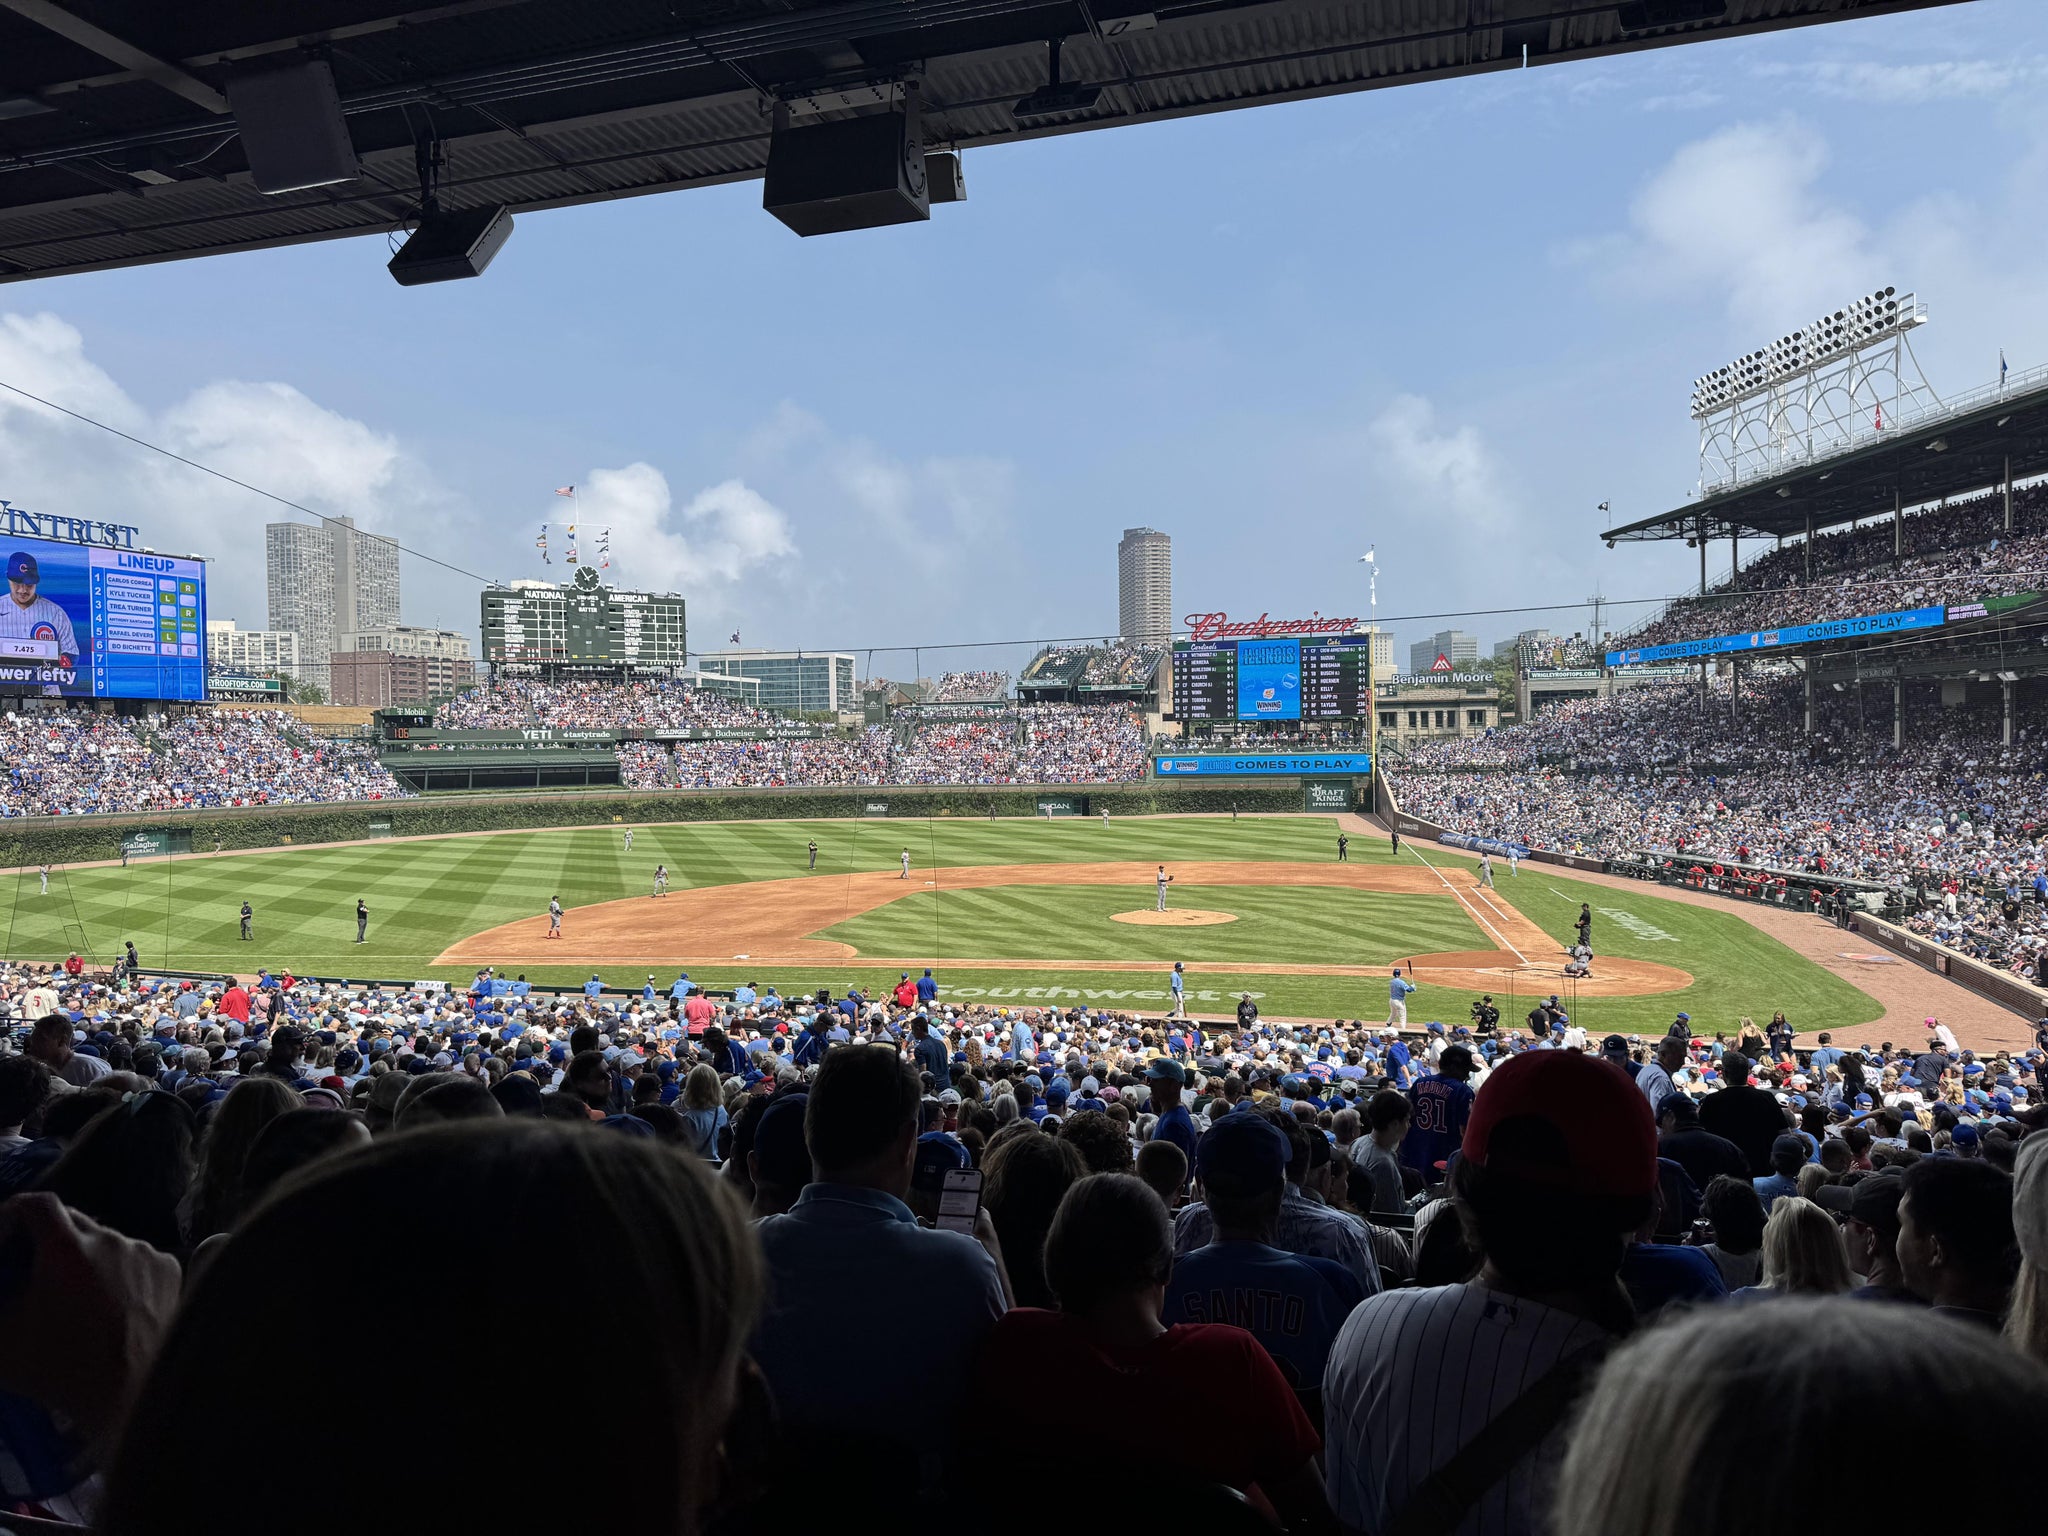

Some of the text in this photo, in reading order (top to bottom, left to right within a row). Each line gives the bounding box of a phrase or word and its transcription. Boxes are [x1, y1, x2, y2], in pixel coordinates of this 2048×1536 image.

[0, 500, 139, 549] INTRUST
[118, 554, 175, 572] LINEUP
[95, 574, 100, 582] 1
[95, 588, 101, 596] 2
[524, 590, 567, 600] NATIONAL
[608, 594, 649, 603] AMERICAN
[96, 601, 102, 609] 3
[1184, 611, 1359, 641] Budweiser
[1808, 624, 1848, 638] COMES
[1852, 621, 1867, 632] TO
[1870, 616, 1903, 630] PLAY
[97, 641, 103, 649] 6
[1659, 647, 1686, 657] COMES
[1689, 644, 1700, 653] TO
[1702, 640, 1724, 651] PLAY
[1242, 646, 1296, 666] ILLINOIS
[98, 668, 104, 676] 8
[1618, 668, 1686, 676] WRIGLEYROOFTOPS.COM
[1392, 672, 1494, 686] Benjamin Moore
[98, 681, 104, 690] 9
[522, 730, 552, 739] YETI
[569, 731, 610, 740] tastytrade
[1203, 760, 1232, 770] ILLINOIS
[1234, 760, 1286, 770] COMES
[1291, 760, 1310, 768] TO
[1314, 760, 1352, 768] PLAY
[1312, 787, 1346, 798] DRAFT
[124, 840, 160, 849] Gallagher
[33, 995, 41, 1008] 5
[1416, 1096, 1448, 1134] 31
[1182, 1288, 1305, 1336] SANTO
